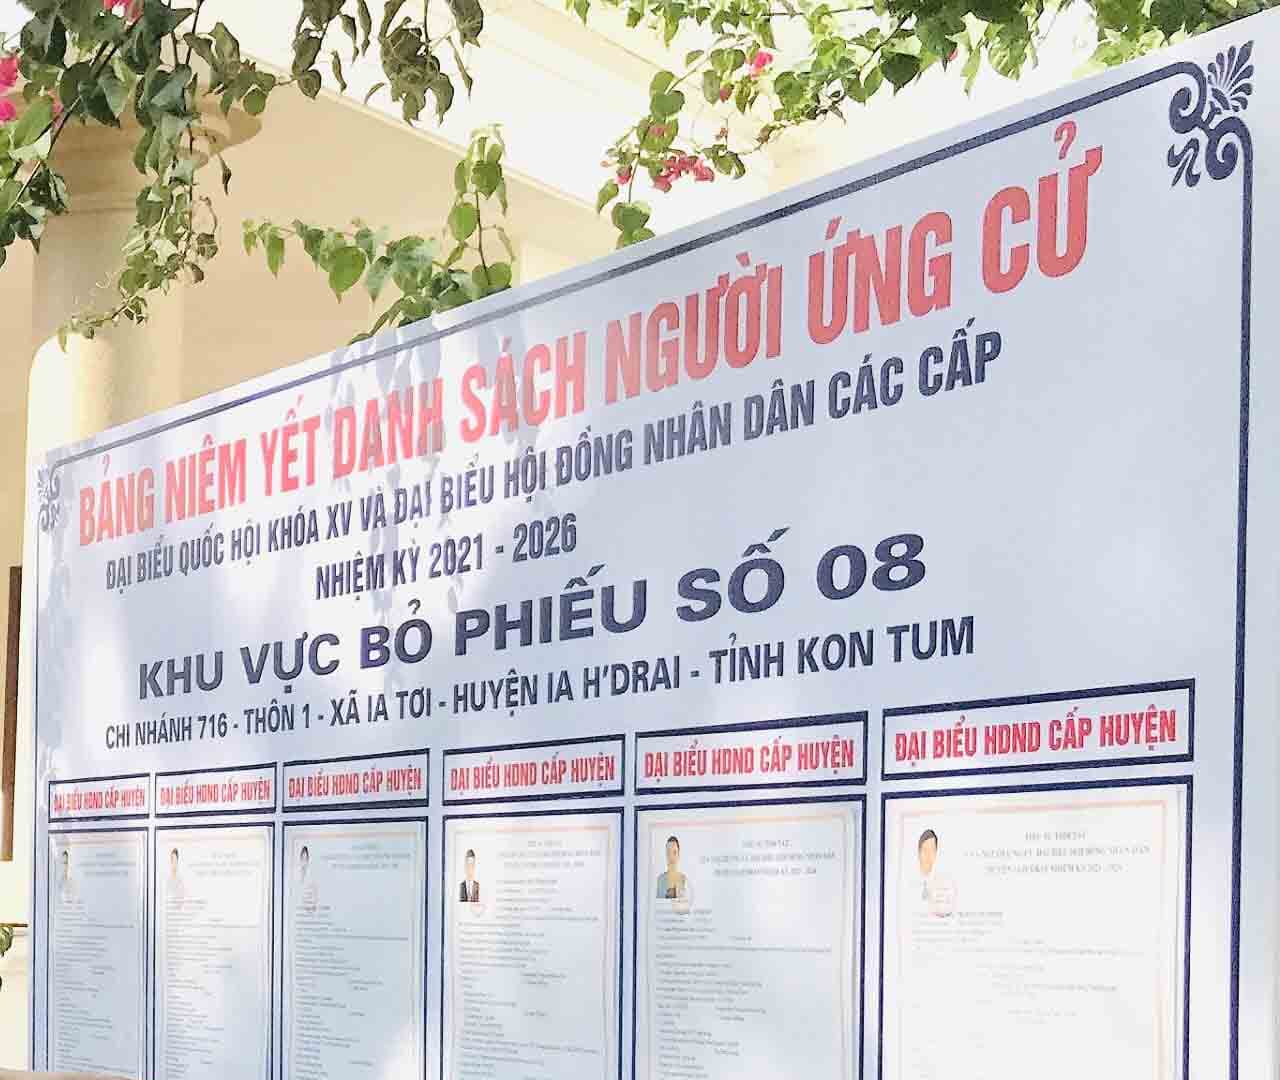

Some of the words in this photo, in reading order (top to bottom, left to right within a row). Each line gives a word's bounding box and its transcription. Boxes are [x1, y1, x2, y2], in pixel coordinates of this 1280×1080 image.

[79, 454, 155, 546] BẢNG
[165, 433, 247, 523] NIÊM
[260, 394, 321, 497] YẾT
[332, 377, 445, 479] DANH
[460, 336, 587, 443] SÁCH
[604, 251, 783, 405] NGƯỜI
[807, 215, 953, 346] ỨNG
[981, 120, 1103, 294] CỬ
[105, 553, 132, 594] ĐẠI
[136, 533, 174, 584] BIỂU
[178, 521, 225, 577] QUỐC
[231, 519, 261, 566] HỘI
[268, 504, 319, 553] KHÓA
[326, 500, 353, 541] XV
[360, 484, 387, 532] VÀ
[393, 480, 431, 528] ĐẠI
[440, 452, 495, 514] BIỂU
[504, 446, 546, 503] HỘI
[556, 424, 633, 487] ĐỒNG
[643, 400, 732, 465] NHÂN
[743, 377, 815, 441] DÂN
[828, 351, 904, 419] CÁC
[918, 317, 1002, 397] CẤP
[139, 651, 224, 700] KHU
[239, 631, 340, 694] VỰC
[359, 598, 433, 669] BỎ
[454, 563, 648, 656] PHIẾU
[676, 527, 791, 623] SỐ
[816, 533, 926, 600] 08
[315, 550, 385, 601] NHIỆM
[392, 538, 421, 587] KỲ
[428, 533, 483, 578] 2021
[511, 513, 577, 563] 2026
[105, 723, 130, 749] CHI
[135, 712, 192, 747] NHÁNH
[197, 712, 228, 740] 716
[243, 699, 295, 735] THÔN
[301, 703, 310, 729] 1
[330, 689, 361, 727] XÃ
[367, 693, 389, 723] IA
[396, 688, 431, 720] TƠI
[453, 668, 538, 718] HUYỆN
[547, 670, 574, 704] IA
[583, 656, 680, 700] H'DRAI
[708, 632, 784, 684] TỈNH
[797, 629, 874, 674] KON
[886, 615, 974, 663] TUM
[895, 731, 926, 767] ĐẠI
[932, 715, 977, 759] BIỂU
[983, 720, 1041, 756] HDND
[1048, 706, 1093, 751] CẤP
[1099, 704, 1177, 751] HUYỆN
[644, 751, 668, 783] ĐẠI
[672, 738, 707, 776] BIỂU
[712, 746, 755, 775] HDND
[759, 735, 792, 773] CẤP
[797, 734, 854, 774] HUYỆN
